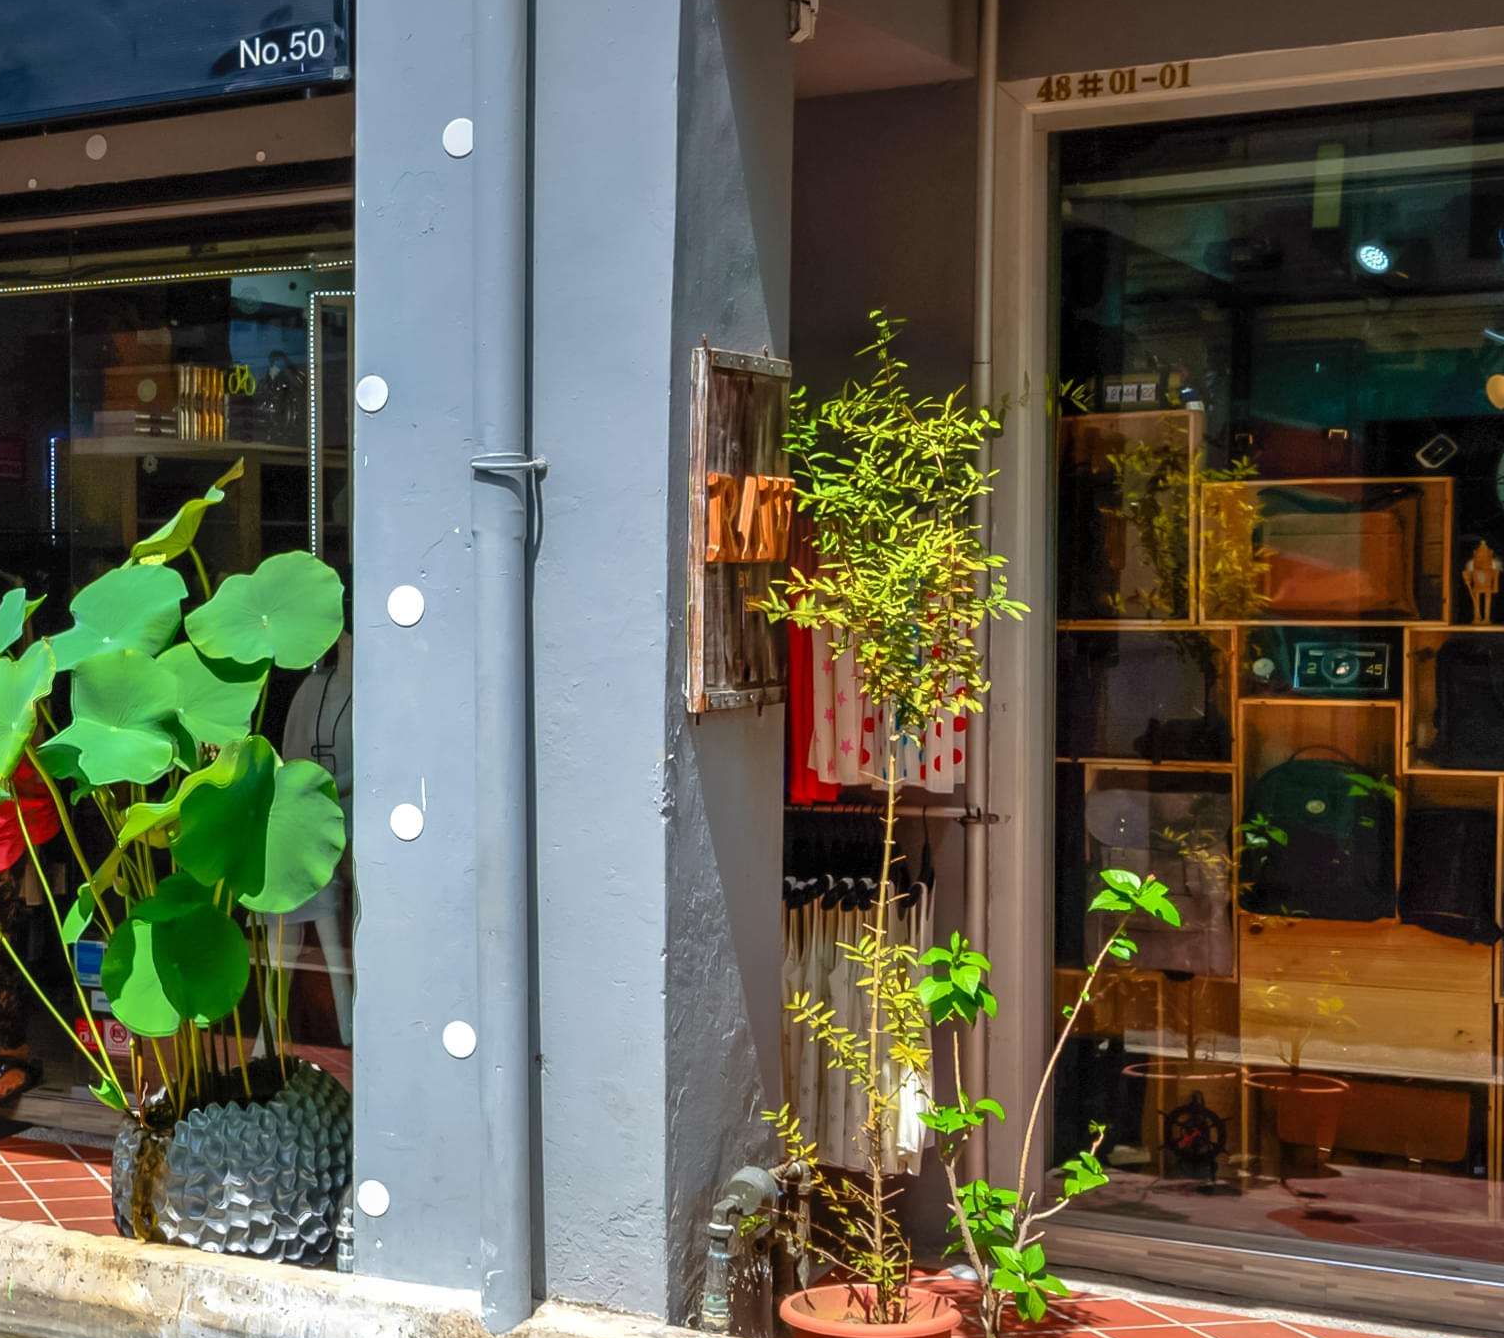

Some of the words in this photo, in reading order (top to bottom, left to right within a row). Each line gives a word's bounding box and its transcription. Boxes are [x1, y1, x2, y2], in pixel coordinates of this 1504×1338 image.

[239, 28, 325, 69] No.50
[1037, 75, 1071, 102] 48
[1078, 62, 1191, 98] #01-01
